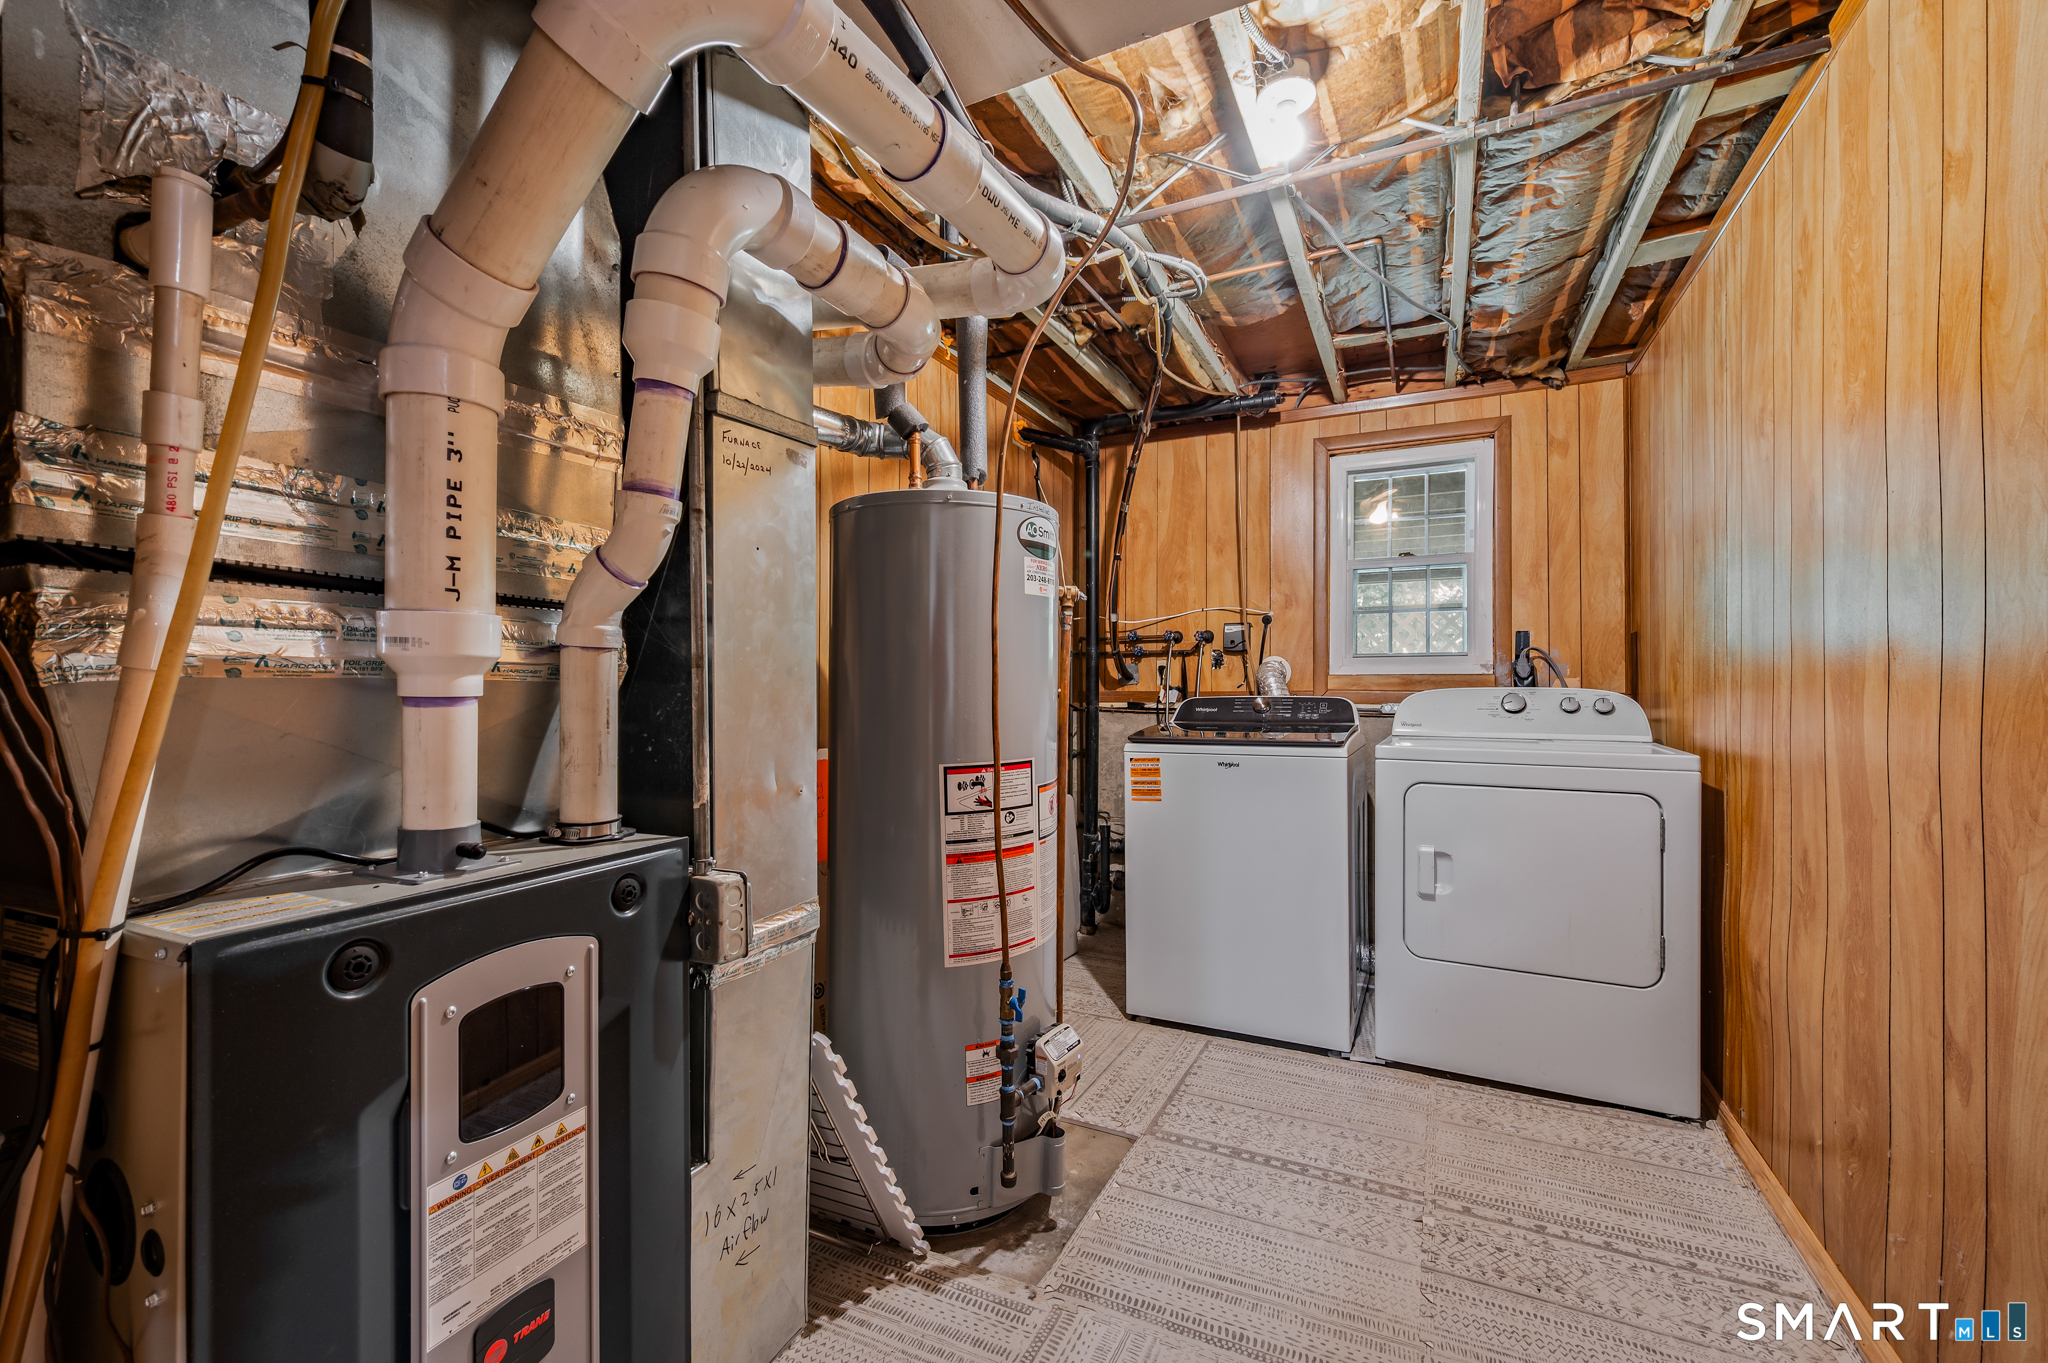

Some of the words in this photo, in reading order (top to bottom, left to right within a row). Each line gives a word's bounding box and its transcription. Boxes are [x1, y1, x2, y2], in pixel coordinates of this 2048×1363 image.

[96, 458, 146, 471] HARDC
[722, 452, 772, 476] 10/22/2024
[167, 471, 178, 488] PSI
[97, 500, 144, 512] HARD
[166, 494, 176, 512] 480
[446, 478, 462, 540] PIPE
[445, 555, 461, 602] J-M
[342, 624, 377, 632] FOIL-GR
[1218, 762, 1240, 770] Whirlpool
[436, 1187, 472, 1210] WARNING
[482, 1153, 536, 1186] AVERTISSEMENT
[545, 1125, 586, 1152] ADVERTENCIA
[513, 1309, 550, 1344] TRANE
